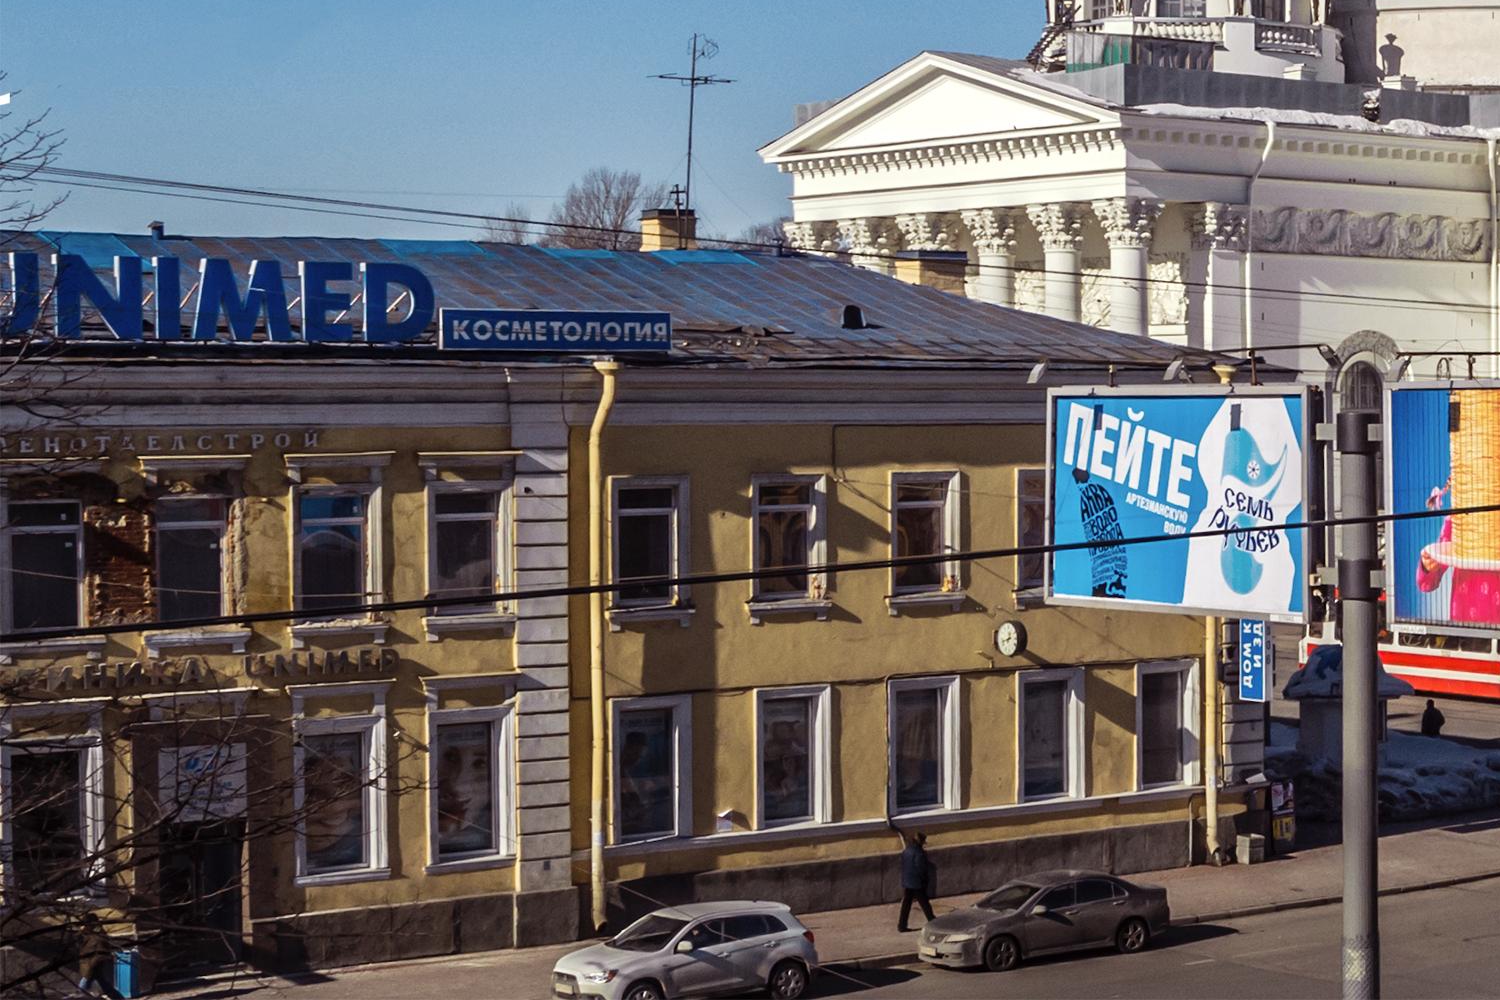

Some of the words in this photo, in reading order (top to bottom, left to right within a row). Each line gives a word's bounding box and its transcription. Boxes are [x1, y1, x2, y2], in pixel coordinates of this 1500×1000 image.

[453, 320, 668, 343] КОСМЕТОЛОГИЯ
[1063, 402, 1196, 508] ПЕЙТЕ
[1125, 492, 1188, 524] АРТЕЗИАНСКУЮ
[1225, 488, 1274, 522] СЕМЬ
[245, 648, 401, 678] UNIMED
[1243, 643, 1253, 689] ДОМ
